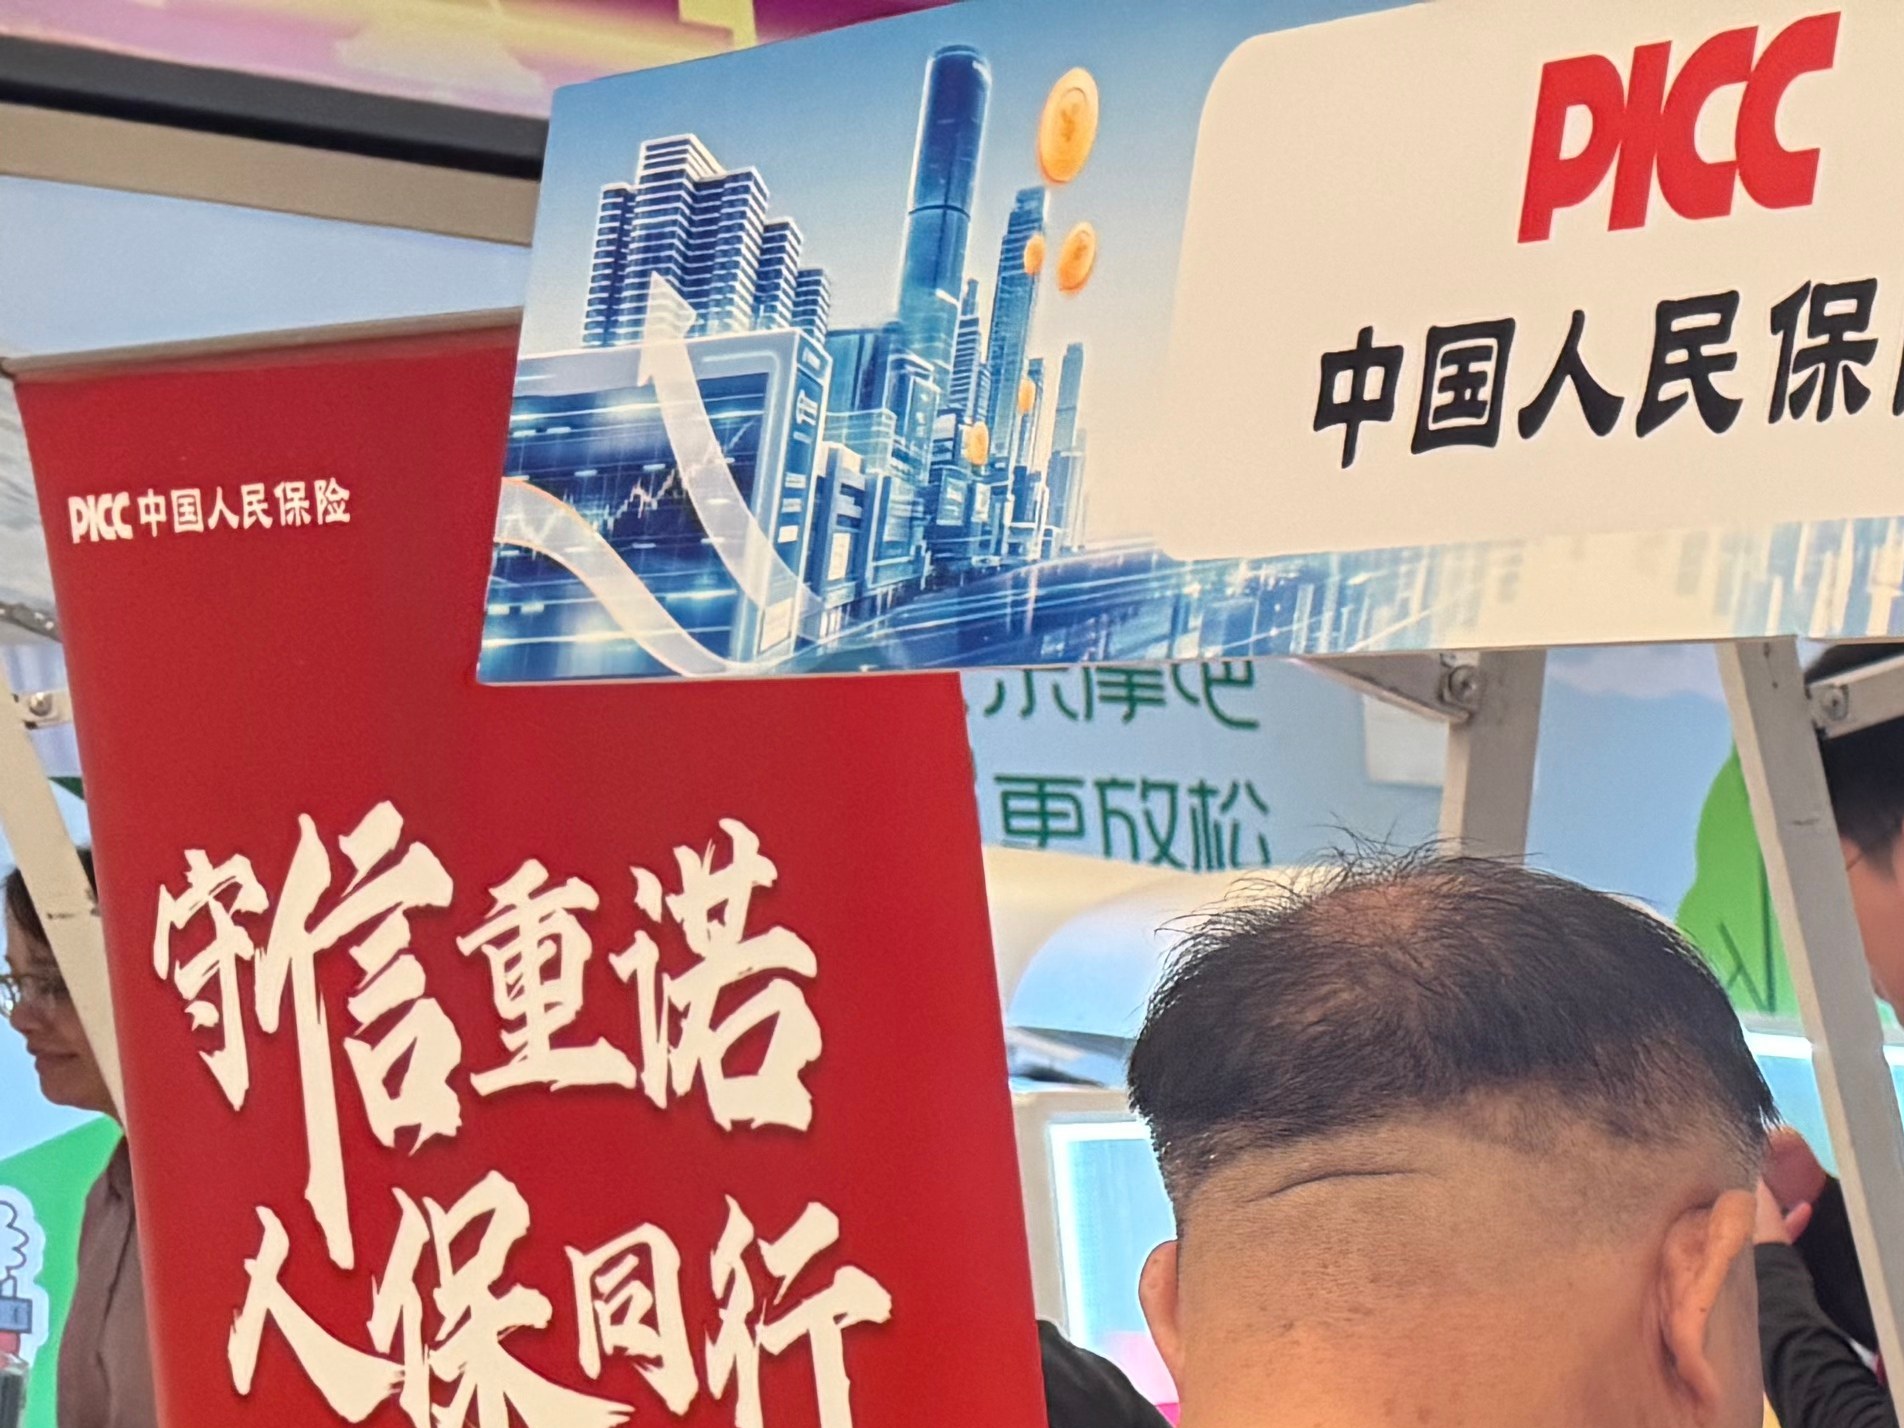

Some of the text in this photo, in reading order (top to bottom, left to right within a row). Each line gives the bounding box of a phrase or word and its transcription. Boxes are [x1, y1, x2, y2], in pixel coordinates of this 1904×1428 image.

[1517, 10, 1841, 244] PICC
[70, 480, 352, 544] PICC 中国人民保险
[152, 800, 822, 1270] 守信重诺
